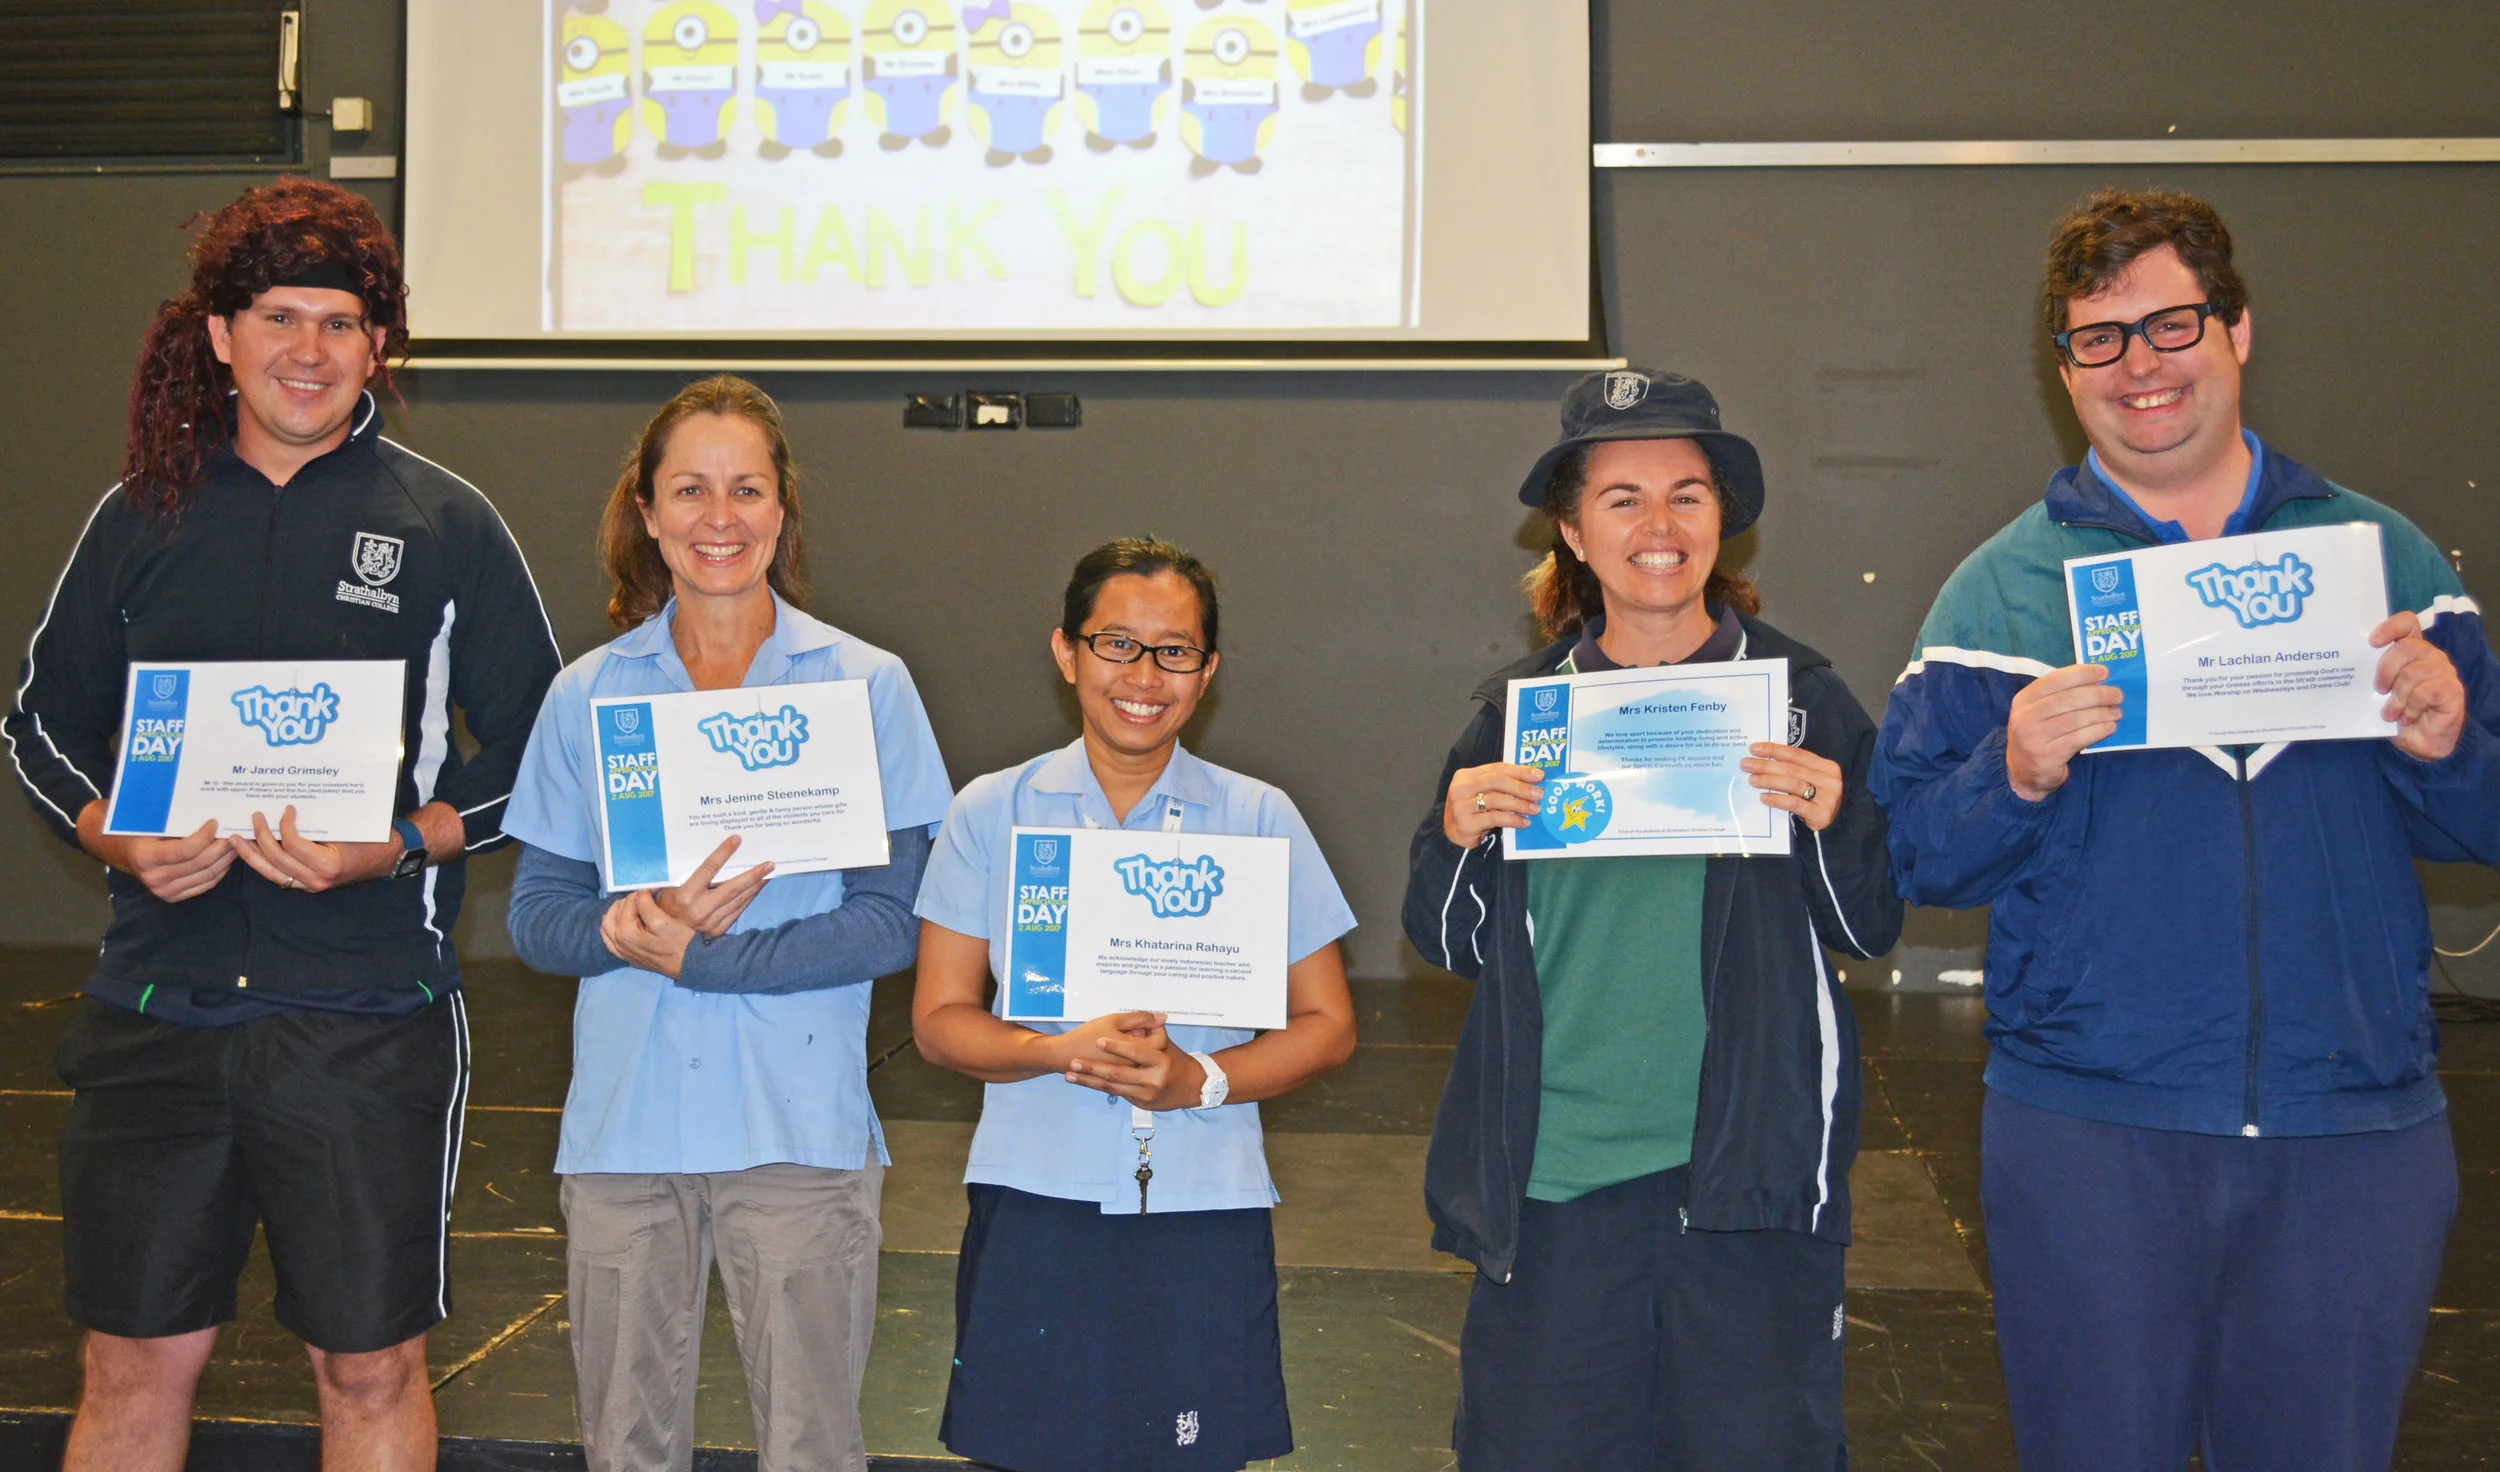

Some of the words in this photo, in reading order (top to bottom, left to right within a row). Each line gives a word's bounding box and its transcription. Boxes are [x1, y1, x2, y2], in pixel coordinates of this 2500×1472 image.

[641, 181, 1010, 295] THANK
[1043, 186, 1248, 307] YOU
[2191, 558, 2307, 602] Thank
[336, 594, 370, 606] CHRISTIAN
[338, 580, 399, 604] Strathalbyn
[2085, 611, 2137, 631] STAFF
[2087, 630, 2140, 656] DAY
[2098, 653, 2118, 662] AUG
[2198, 657, 2216, 667] Mr
[2219, 654, 2271, 666] Lachlan
[2275, 650, 2339, 662] Anderson
[236, 687, 334, 721] Thank
[1620, 706, 1640, 715] Mrs
[1644, 704, 1687, 714] Kristen
[1691, 702, 1727, 712] Fenby
[137, 719, 184, 732] STAFF
[703, 709, 803, 748] Thank
[1522, 727, 1566, 742] STAFF
[132, 736, 182, 755] DAY
[1519, 742, 1566, 764] DAY
[608, 752, 655, 769] STAFF
[232, 766, 248, 774] Mr
[250, 766, 284, 774] Jared
[288, 766, 339, 777] Grimsley
[609, 771, 658, 793] DAY
[620, 791, 636, 799] AUG
[700, 795, 722, 806] Mrs
[725, 793, 764, 804] Jenine
[767, 786, 840, 801] Steenekamp
[1119, 858, 1218, 892] Thank
[1020, 885, 1068, 900] STAFF
[1018, 904, 1067, 924] DAY
[1110, 938, 1132, 948] Mrs
[1135, 939, 1192, 951] Khatarina
[1196, 942, 1240, 955] Rahayu
